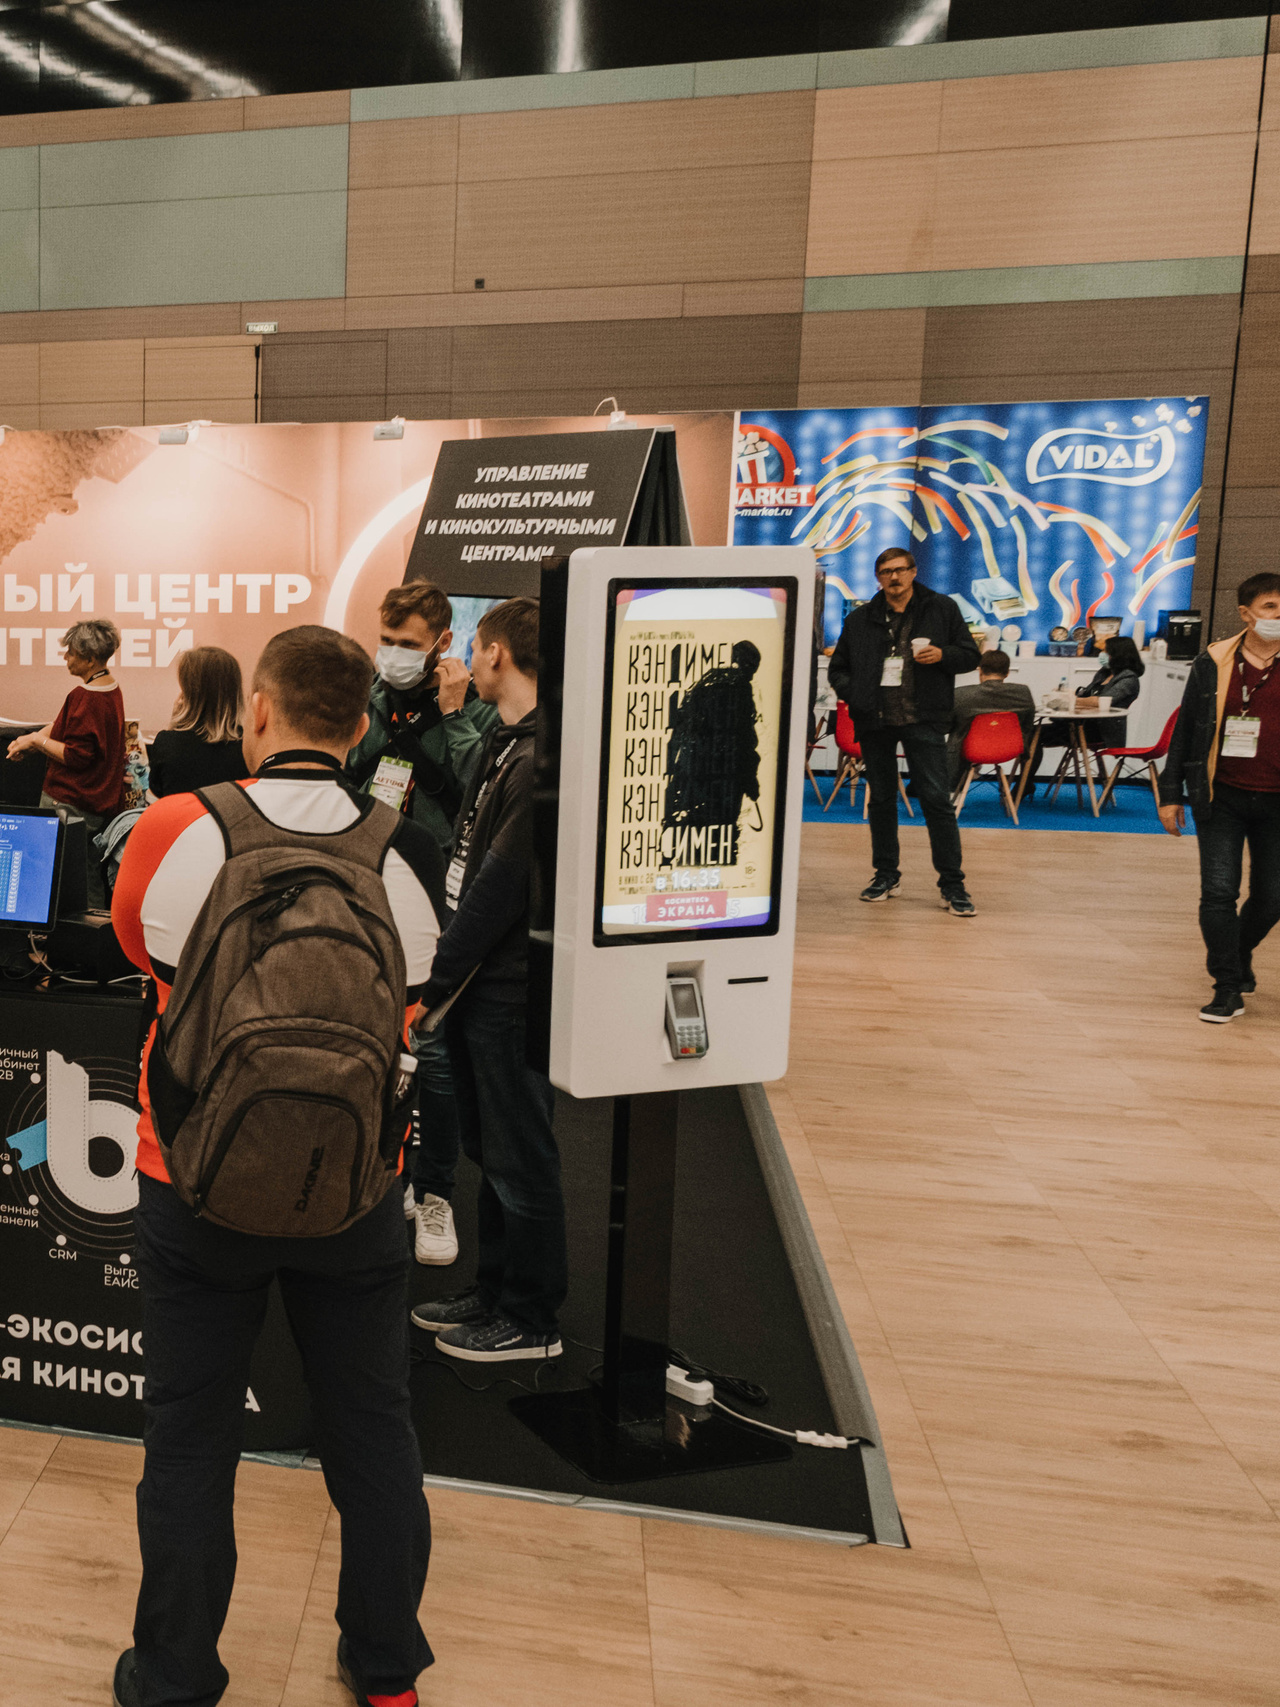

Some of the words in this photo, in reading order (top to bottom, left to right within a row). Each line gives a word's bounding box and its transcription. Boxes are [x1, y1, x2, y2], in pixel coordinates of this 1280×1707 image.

[1047, 441, 1159, 471] VIDAL
[474, 462, 589, 485] УПРАВЛЕНИЕ
[455, 490, 594, 511] КИНОТЕАТРАМИ
[424, 519, 438, 535] И
[439, 517, 617, 536] КИНОКУЛЬТУРНЫМИ
[460, 545, 554, 564] ЦЕНТРАМИ
[114, 573, 312, 619] ЦЕНТР
[628, 642, 737, 688] КЭНДИМЕ
[672, 868, 721, 888] 16:35
[657, 906, 716, 918] ЭКРАНА
[293, 1145, 325, 1214] DAKINE
[48, 1248, 77, 1262] CRM
[104, 1264, 139, 1281] Выгр
[104, 1276, 140, 1290] ЕАИС
